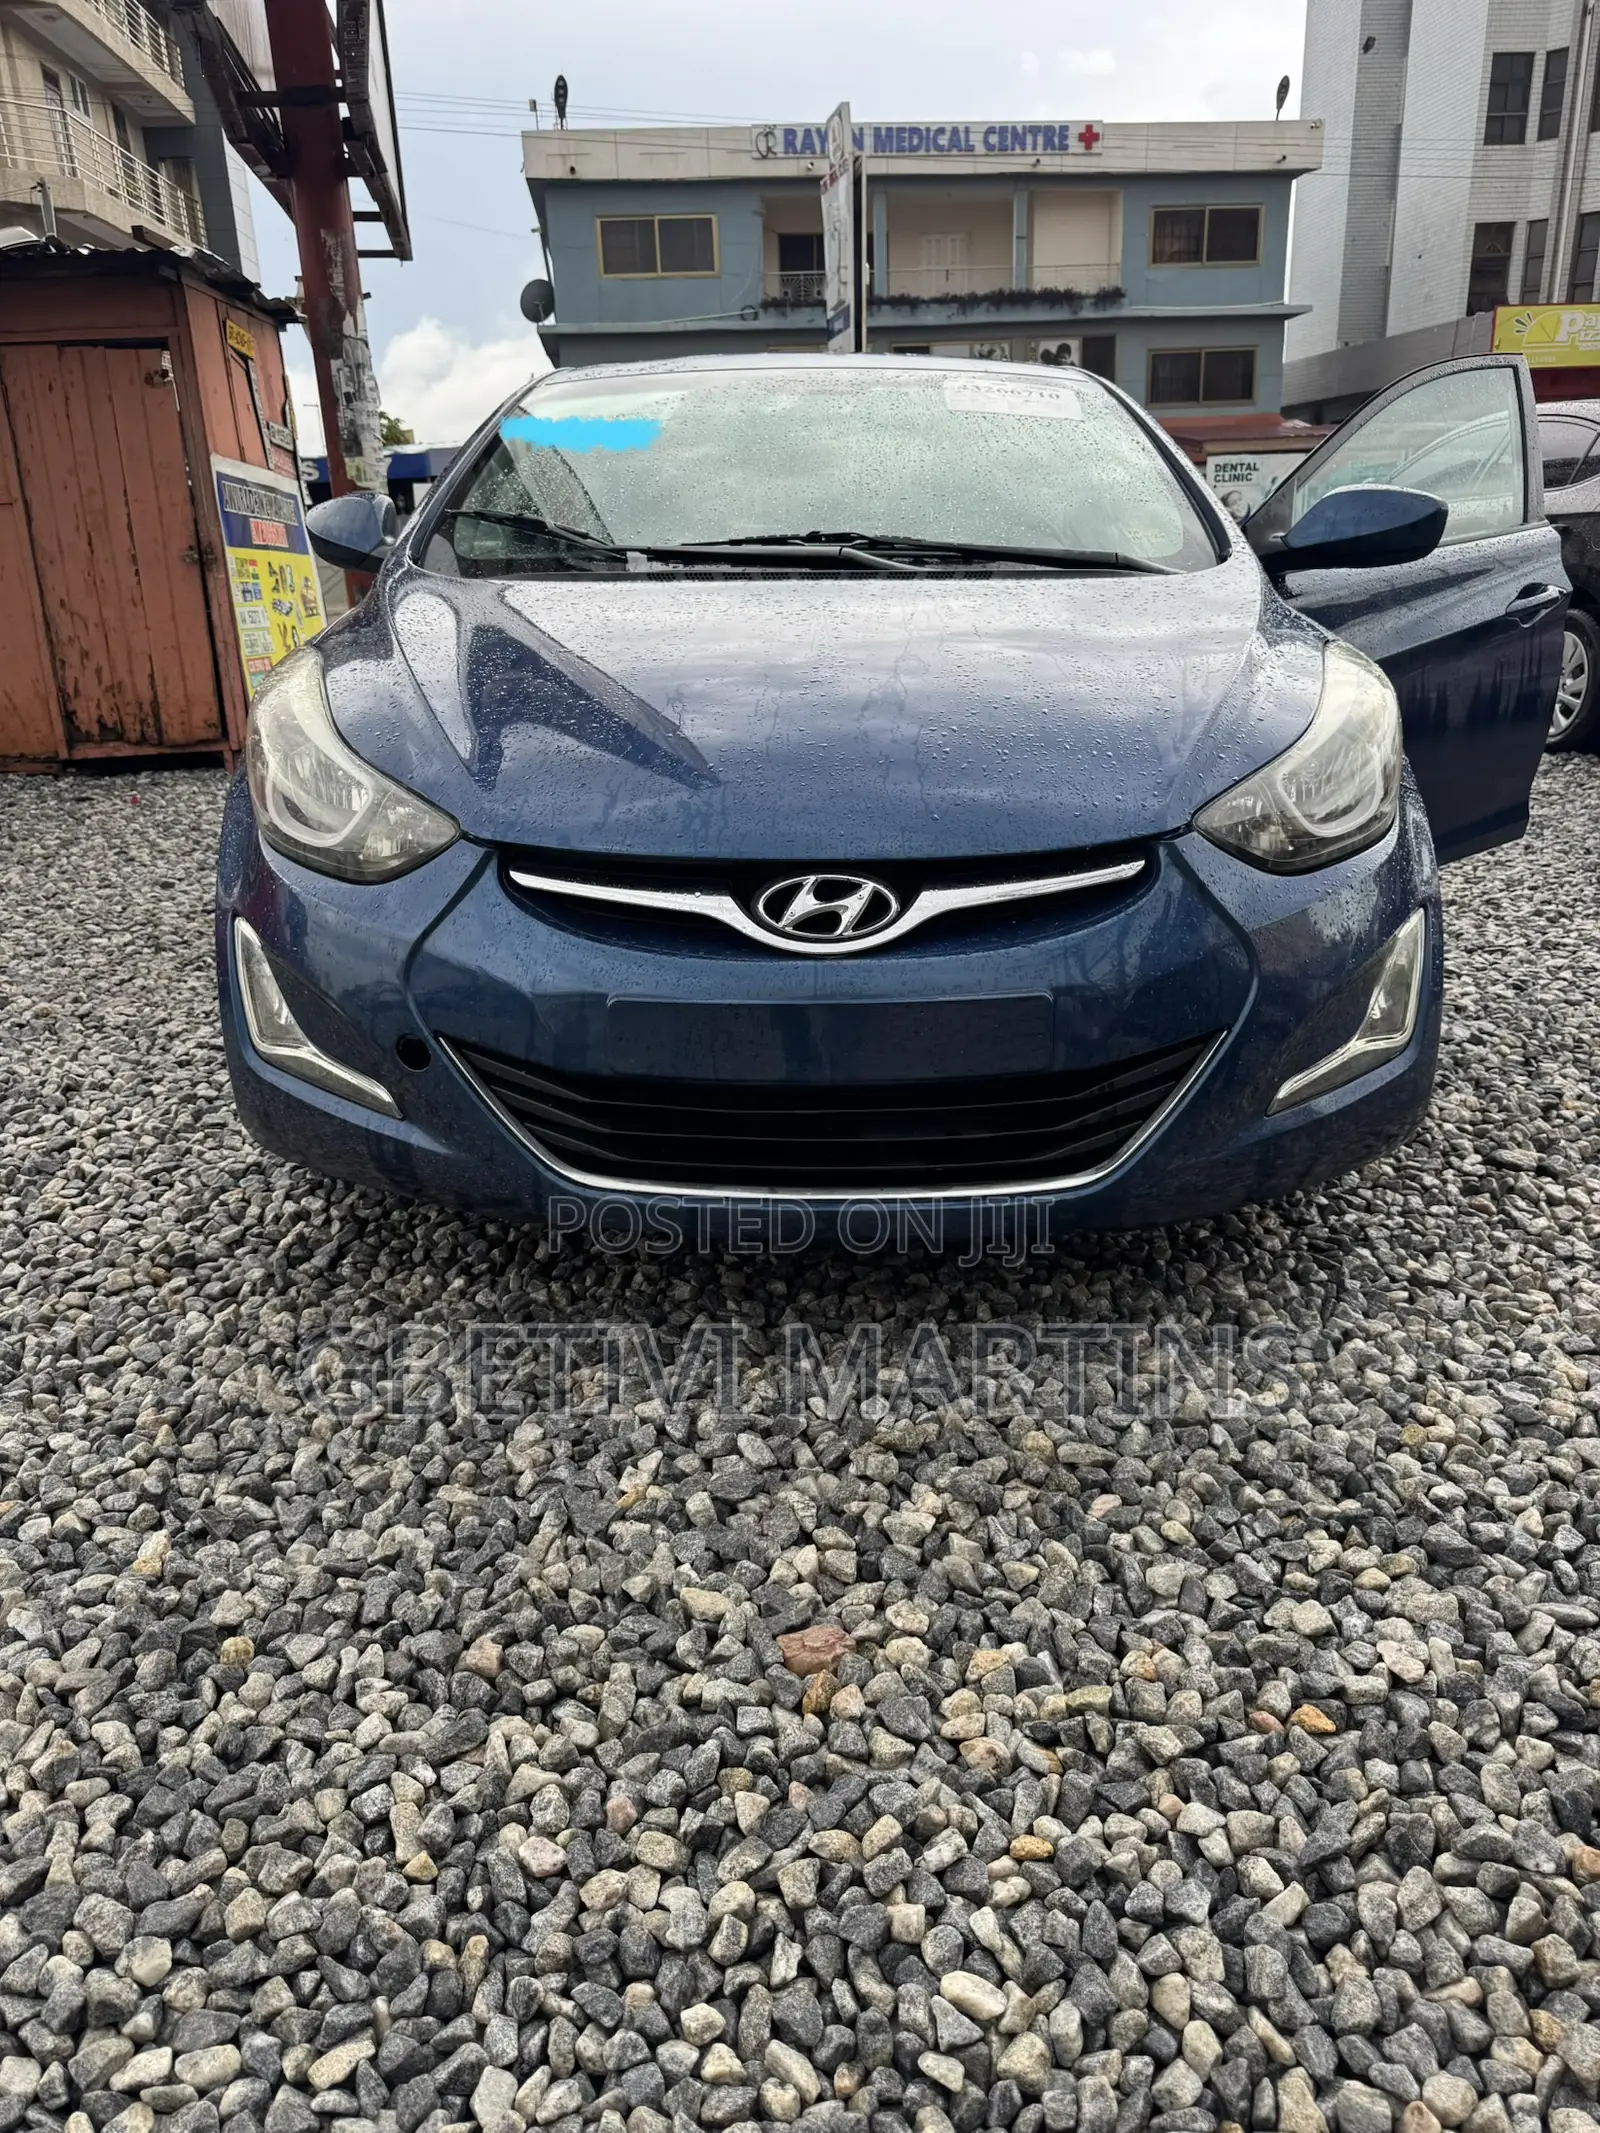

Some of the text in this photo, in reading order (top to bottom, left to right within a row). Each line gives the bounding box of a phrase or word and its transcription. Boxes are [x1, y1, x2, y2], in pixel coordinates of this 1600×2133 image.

[783, 127, 864, 155] RAYN
[873, 125, 975, 153] MEDICAL
[983, 124, 1070, 152] CENTRE
[1214, 463, 1259, 473] DENTAL
[1214, 473, 1253, 483] CLINIC
